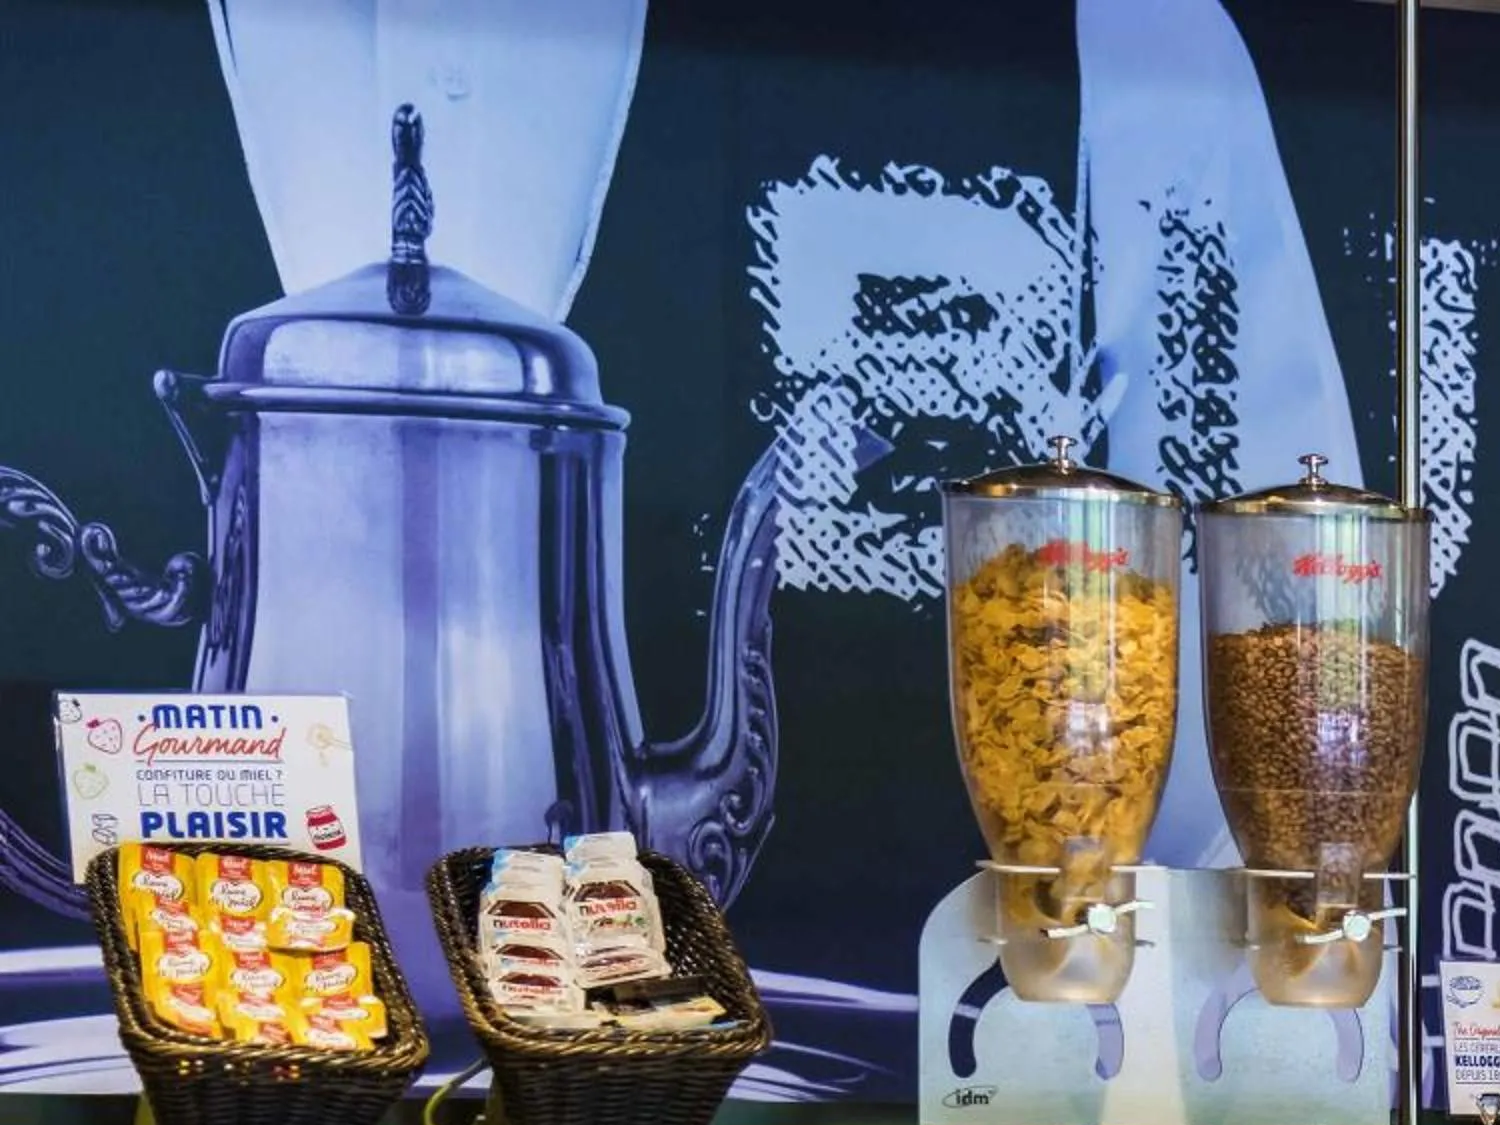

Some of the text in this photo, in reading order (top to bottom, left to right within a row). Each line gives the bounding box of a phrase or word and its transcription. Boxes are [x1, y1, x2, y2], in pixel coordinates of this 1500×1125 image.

[152, 703, 263, 729] MATIN
[133, 723, 287, 766] Gourmand
[136, 769, 213, 781] CONFITURE
[217, 769, 236, 781] OU
[239, 769, 273, 781] MIEL
[137, 783, 285, 807] LA TOUCHE
[140, 811, 289, 839] PLAISIR
[493, 918, 551, 931] nutella
[956, 1088, 989, 1105] idm
